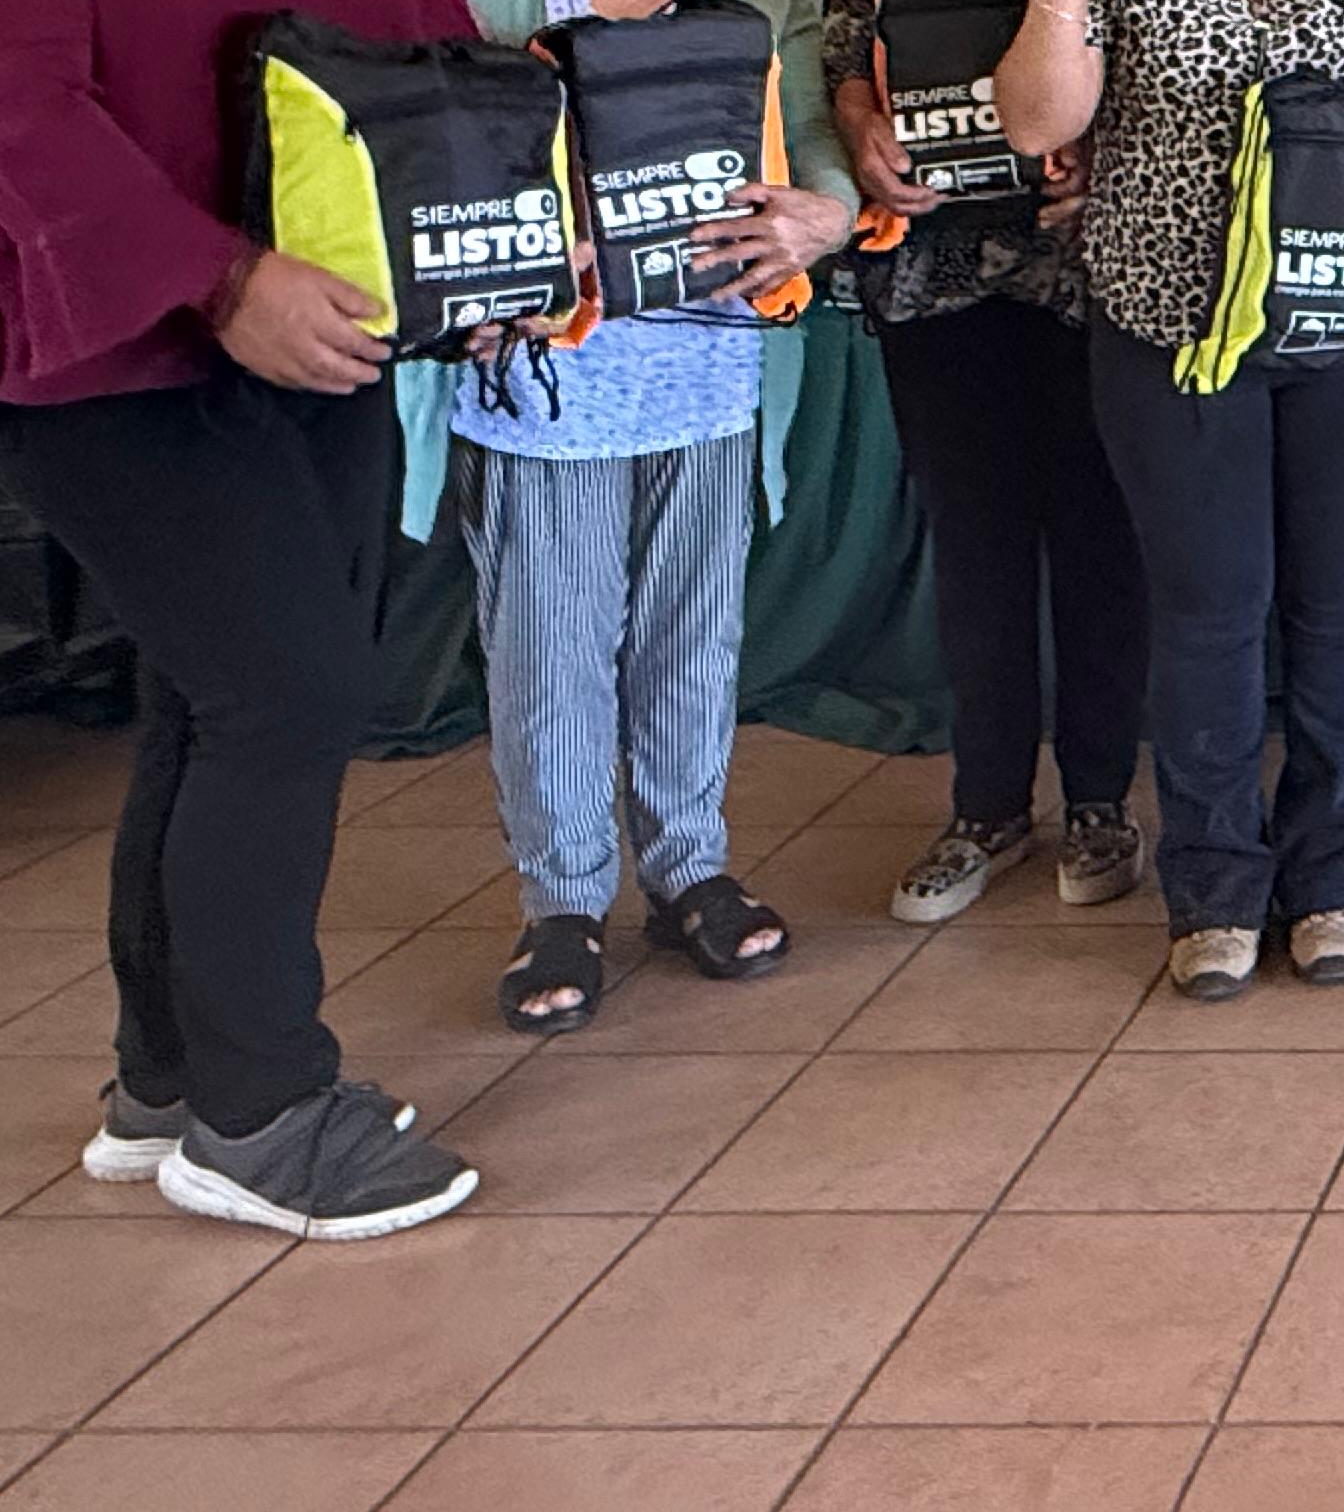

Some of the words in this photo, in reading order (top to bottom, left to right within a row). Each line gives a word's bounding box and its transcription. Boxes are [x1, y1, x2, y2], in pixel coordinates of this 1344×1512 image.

[891, 85, 970, 109] SIEMPRE
[894, 103, 1002, 142] LISTO
[592, 161, 685, 192] SIEMPRE
[411, 199, 512, 228] SIEMPRE
[413, 220, 563, 269] LISTOS
